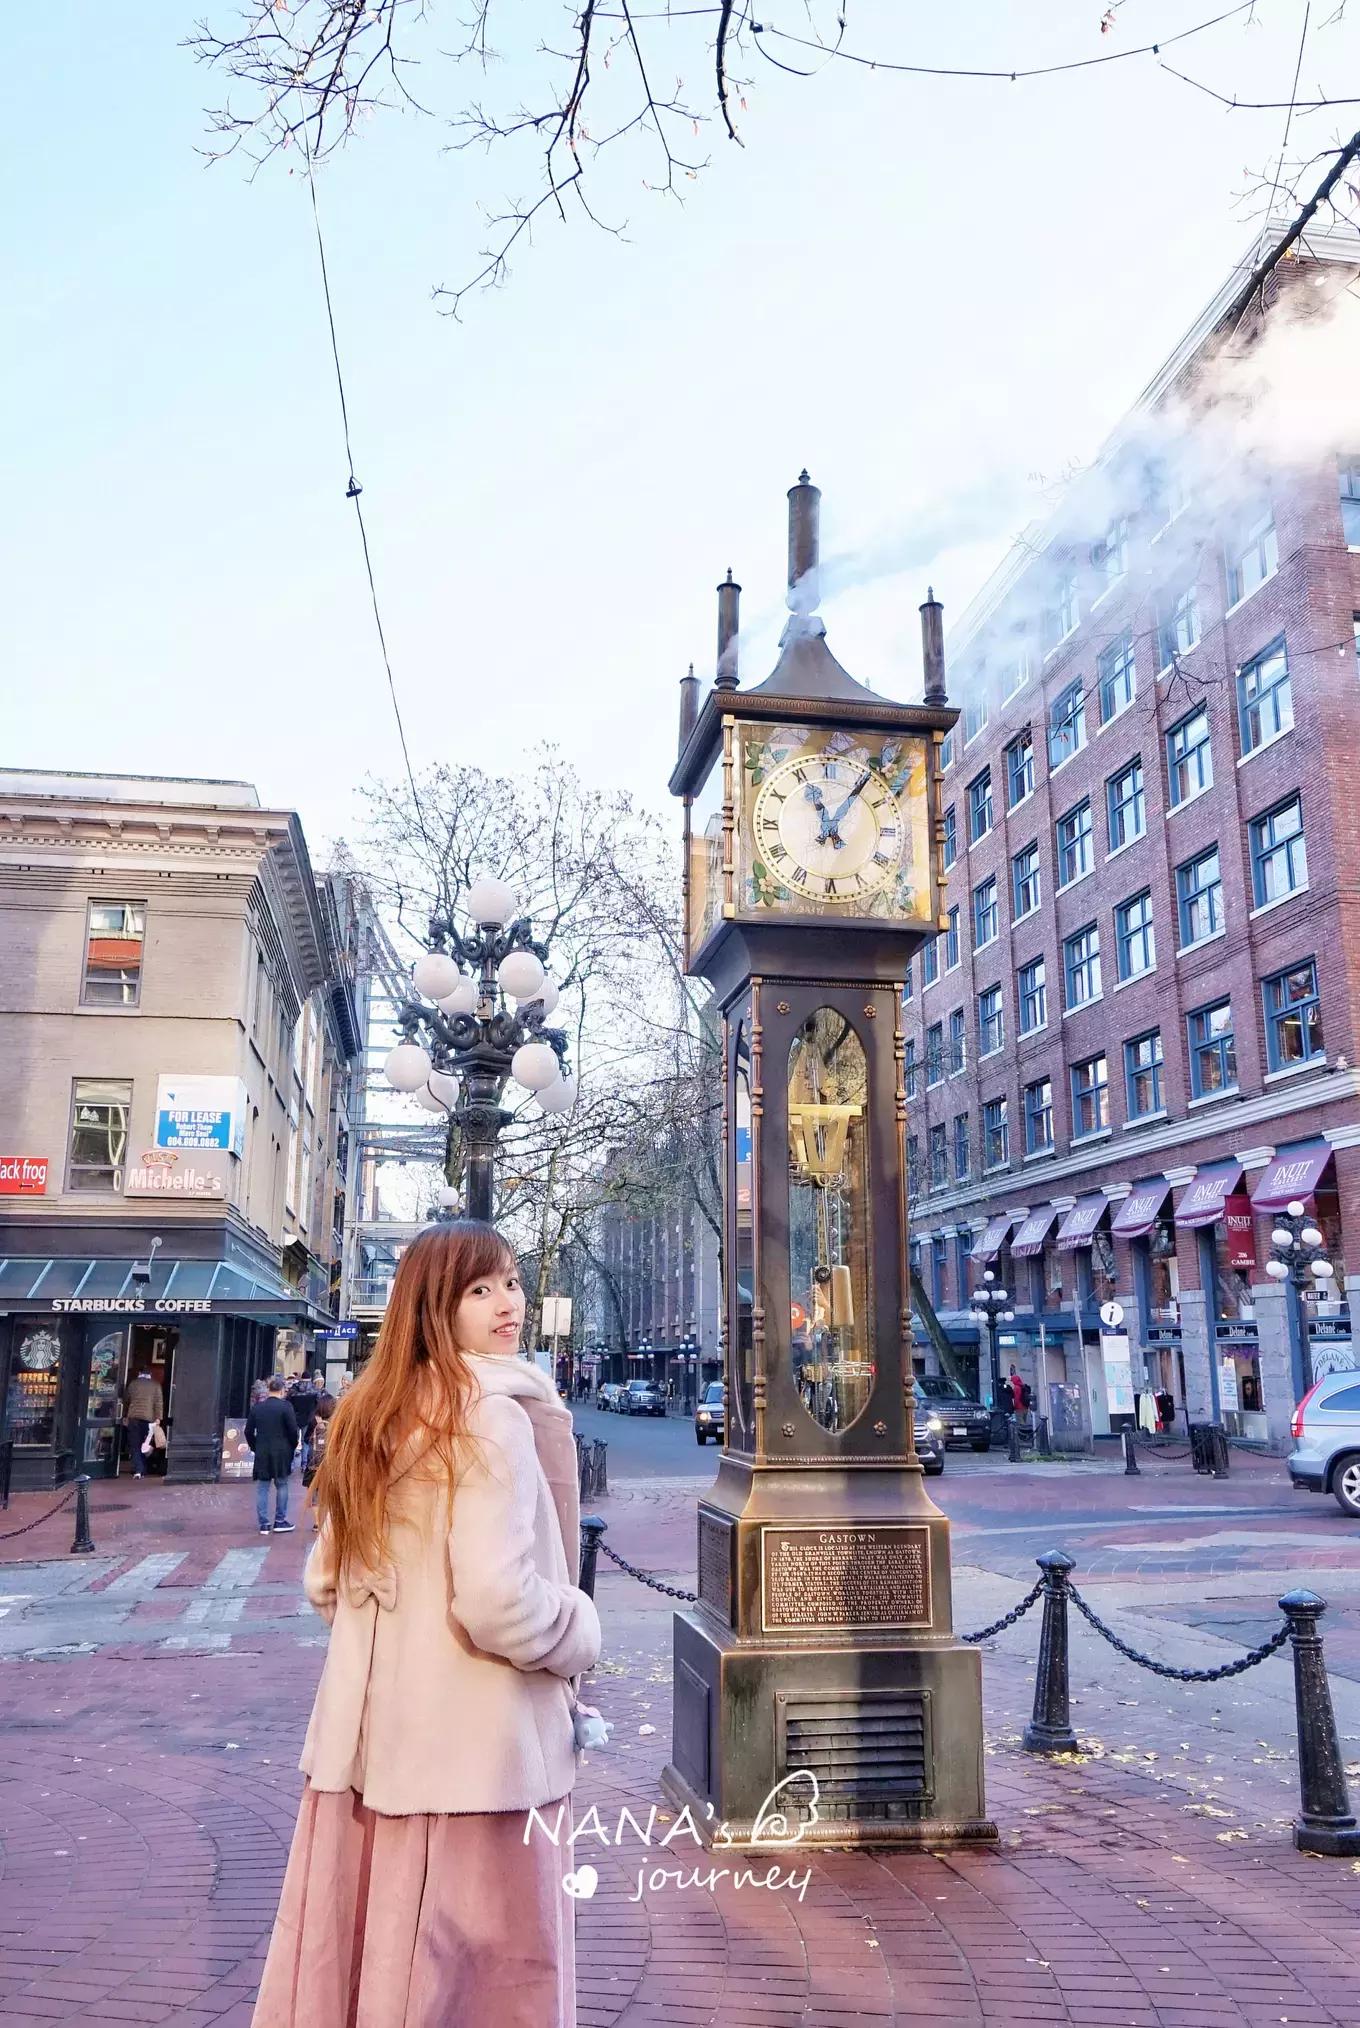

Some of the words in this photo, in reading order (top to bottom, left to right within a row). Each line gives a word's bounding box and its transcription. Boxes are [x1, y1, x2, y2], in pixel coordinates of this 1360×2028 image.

[770, 789, 786, 803] X
[763, 818, 778, 830] IX
[168, 1111, 188, 1122] FOR
[190, 1112, 222, 1123] LEASE
[23, 1160, 47, 1184] frog
[1274, 1160, 1314, 1182] INUIT
[128, 1168, 221, 1190] Michelle's
[1193, 1179, 1228, 1200] INUIT
[1128, 1195, 1158, 1211] INUIT
[1228, 1216, 1252, 1224] INUIT
[52, 1299, 145, 1312] STARBUCKS
[155, 1300, 212, 1312] COFFEE
[819, 1533, 876, 1543] GASTOWN
